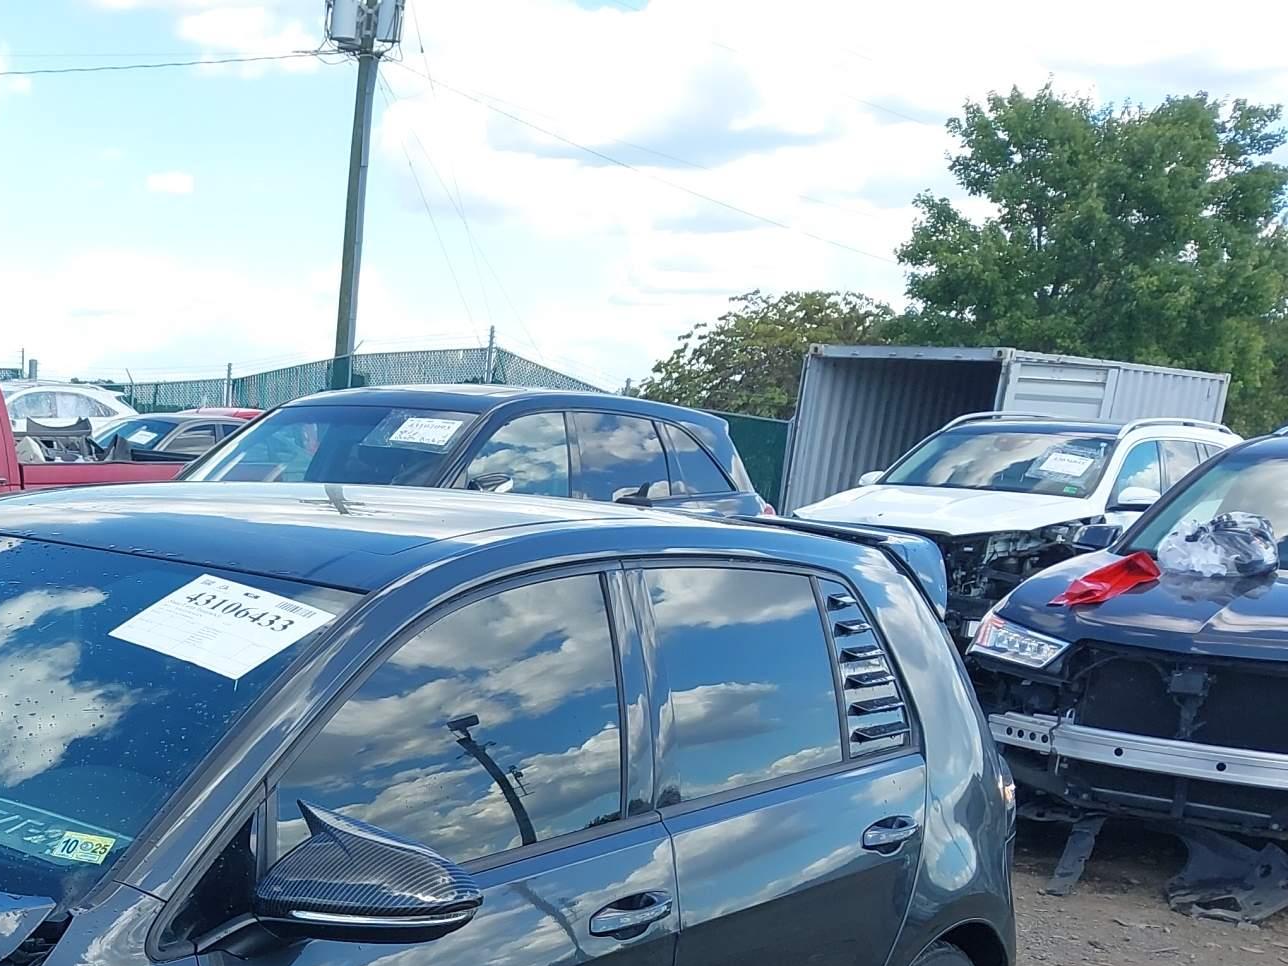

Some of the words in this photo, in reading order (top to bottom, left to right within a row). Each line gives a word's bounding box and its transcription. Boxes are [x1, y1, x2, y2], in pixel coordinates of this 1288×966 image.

[186, 592, 295, 632] 43106433
[61, 838, 79, 854] 10
[91, 843, 110, 855] 25
